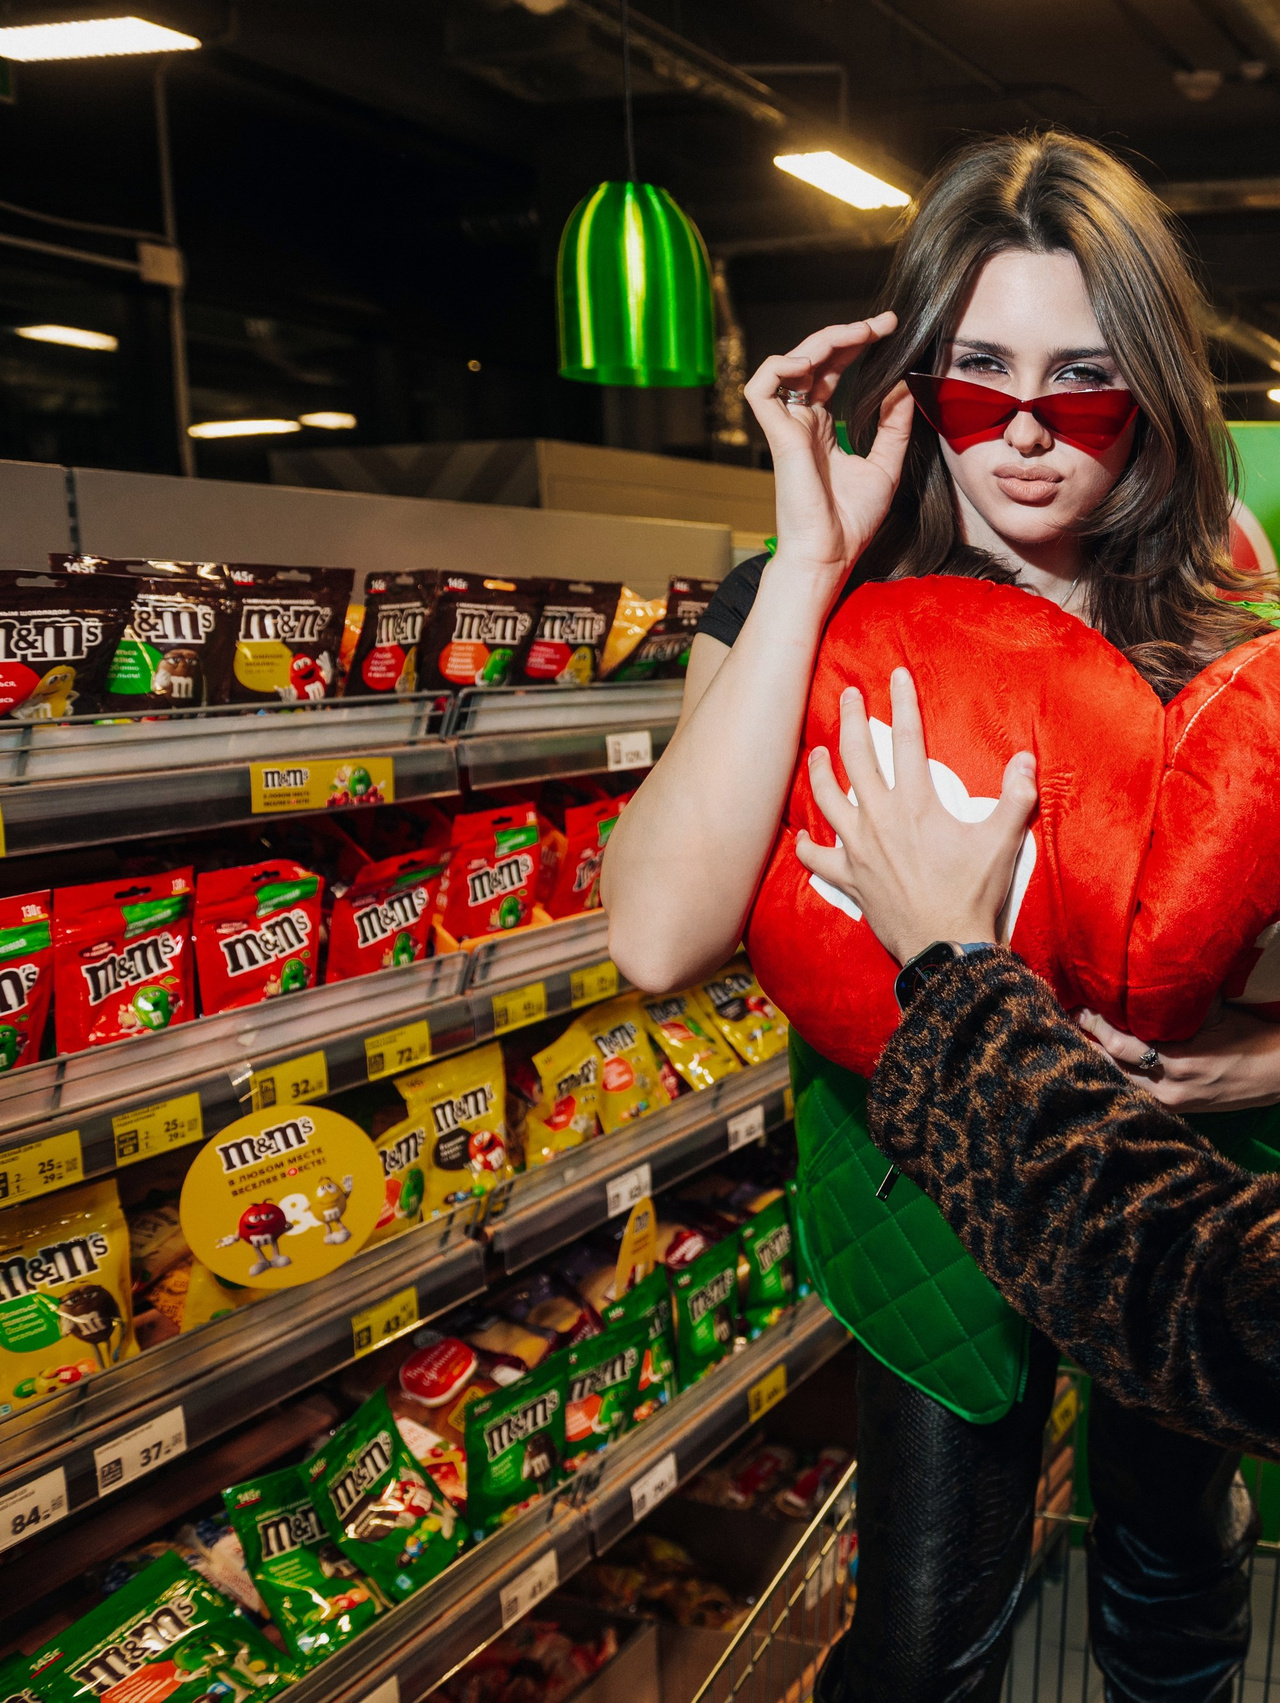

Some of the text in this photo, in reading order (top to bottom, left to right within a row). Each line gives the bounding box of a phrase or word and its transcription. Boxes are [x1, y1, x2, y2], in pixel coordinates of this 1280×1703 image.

[129, 602, 216, 645] &m's
[239, 605, 333, 643] m&m's
[262, 767, 310, 790] m&m's
[468, 853, 534, 907] m&m's
[353, 886, 429, 950] m&m's
[219, 908, 312, 977] m&m's
[81, 932, 178, 1006] m&m's
[291, 1080, 310, 1099] 32
[164, 1119, 178, 1133] 25
[432, 1083, 496, 1136] m&m's
[168, 1132, 179, 1142] 29
[215, 1117, 315, 1175] m&m's
[38, 1158, 55, 1175] 25
[43, 1173, 55, 1185] 29
[239, 1162, 284, 1183] ЛЮБОМ
[287, 1147, 323, 1165] МЕСТЕ
[231, 1175, 278, 1197] ВЕСЕЛЕЕ
[139, 1441, 164, 1468] 37
[11, 1506, 41, 1536] 84
[71, 1596, 198, 1699] m&m's
